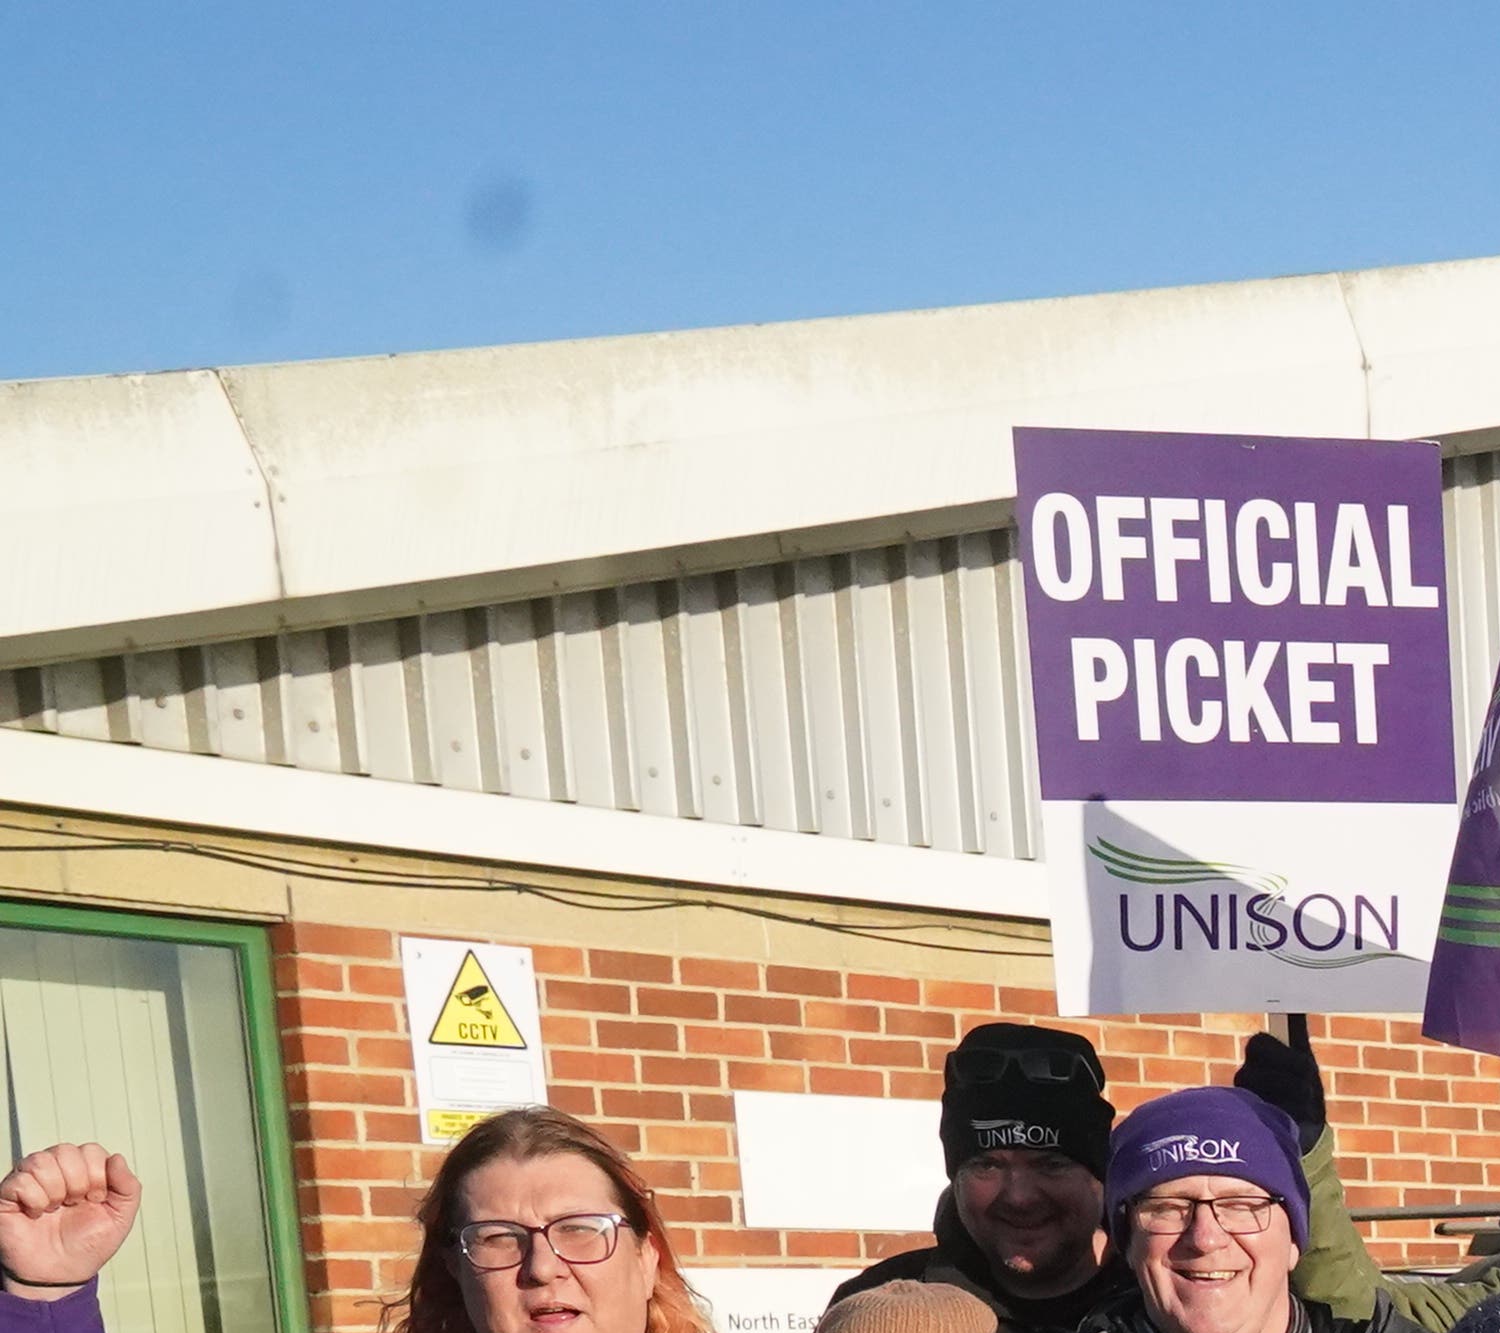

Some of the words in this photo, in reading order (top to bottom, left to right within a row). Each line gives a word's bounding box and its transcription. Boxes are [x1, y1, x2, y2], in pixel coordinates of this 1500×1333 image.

[1031, 492, 1438, 608] OFFICIAL
[1071, 637, 1389, 745] PICKET
[1120, 892, 1398, 951] UNISON
[458, 1023, 497, 1040] CCTV
[977, 1124, 1060, 1149] UNISON
[1148, 1138, 1240, 1171] UNISON
[728, 1313, 780, 1331] North
